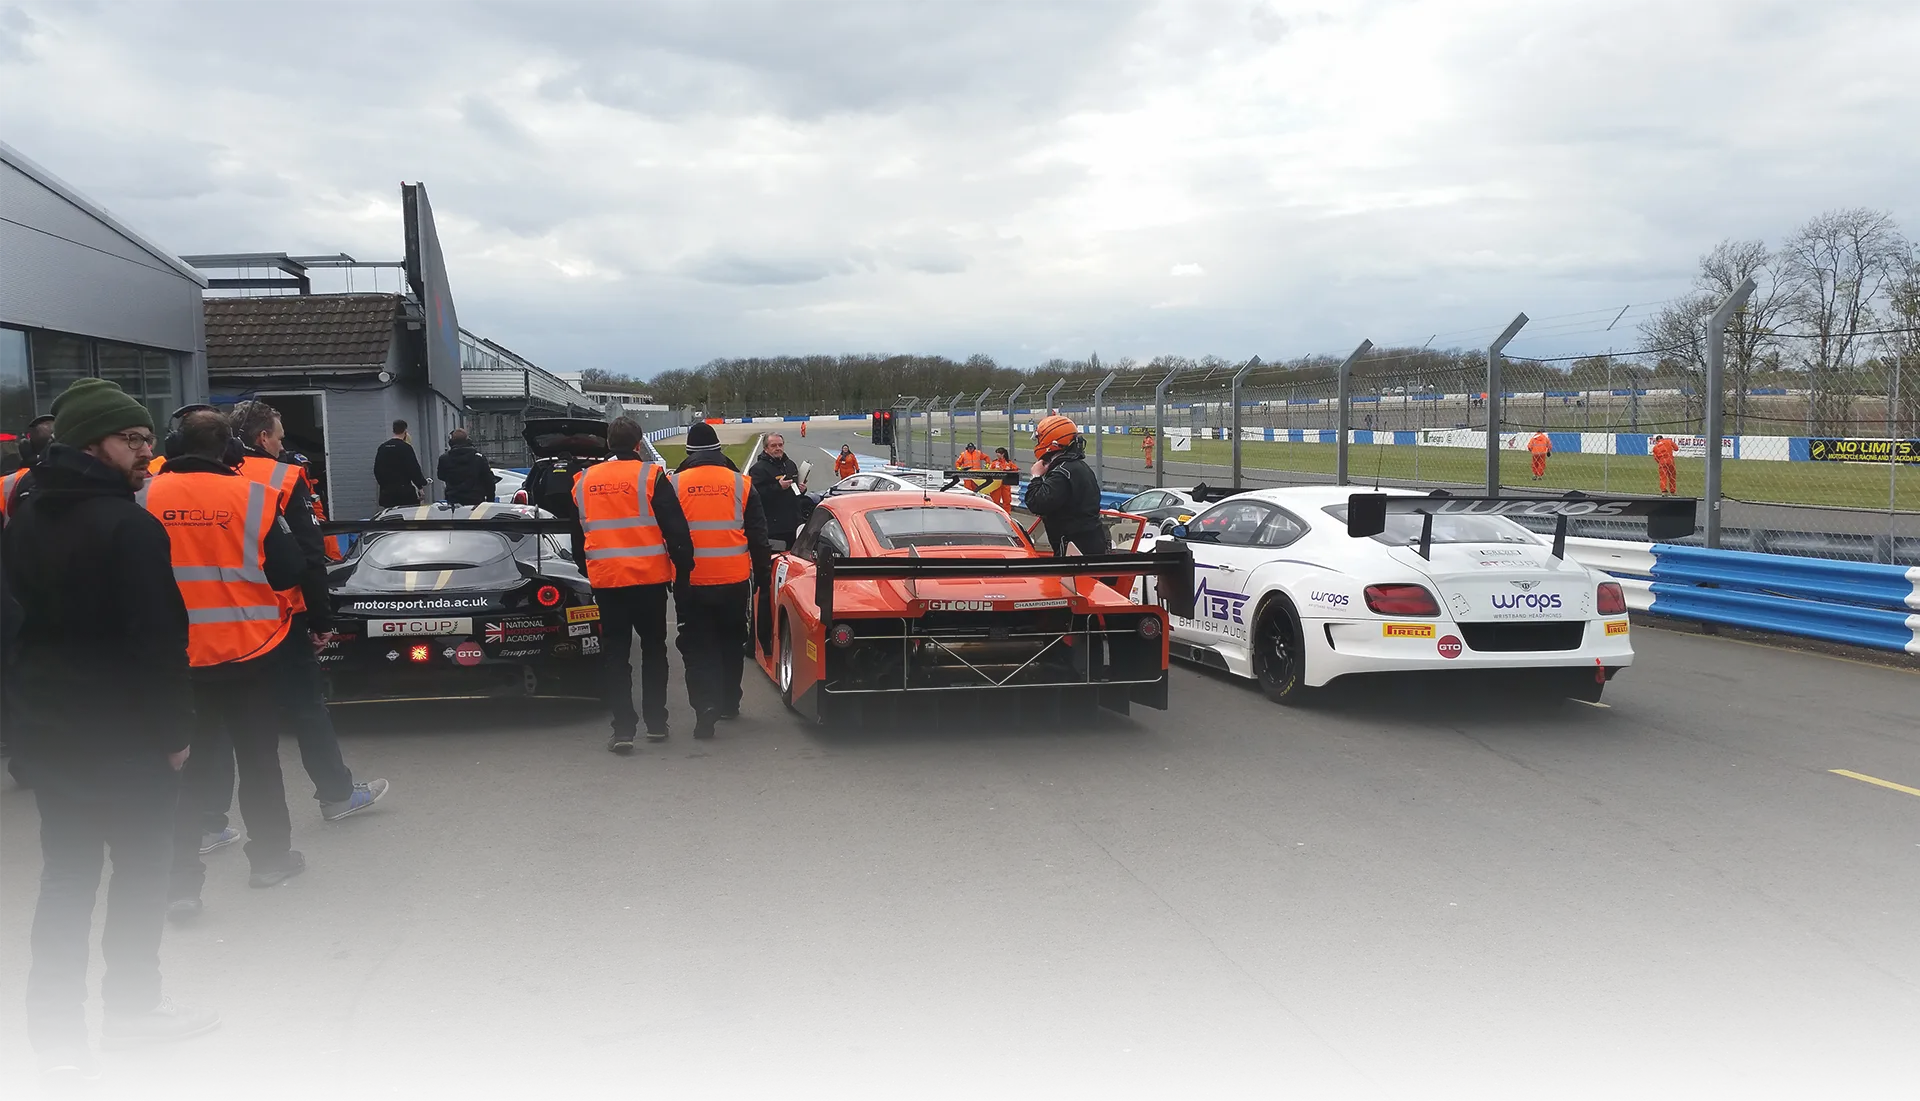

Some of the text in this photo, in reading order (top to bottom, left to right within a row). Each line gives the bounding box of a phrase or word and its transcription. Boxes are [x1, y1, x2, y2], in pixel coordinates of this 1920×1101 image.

[1836, 441, 1857, 453] NO
[353, 597, 488, 611] motorsport.nda.ac.uk
[1014, 600, 1067, 608] CHAMPIONSHIP
[1310, 590, 1349, 606] wraps
[1491, 594, 1562, 612] wraps
[570, 608, 600, 620] PIRELL
[506, 620, 545, 629] NATIONAL
[506, 626, 560, 635] MOTORSPORT
[1179, 619, 1218, 632] BRITISH
[1387, 625, 1431, 637] PIRELLI
[506, 634, 545, 643] ACADEMY
[582, 636, 599, 648] DR
[1439, 643, 1460, 651] GTO
